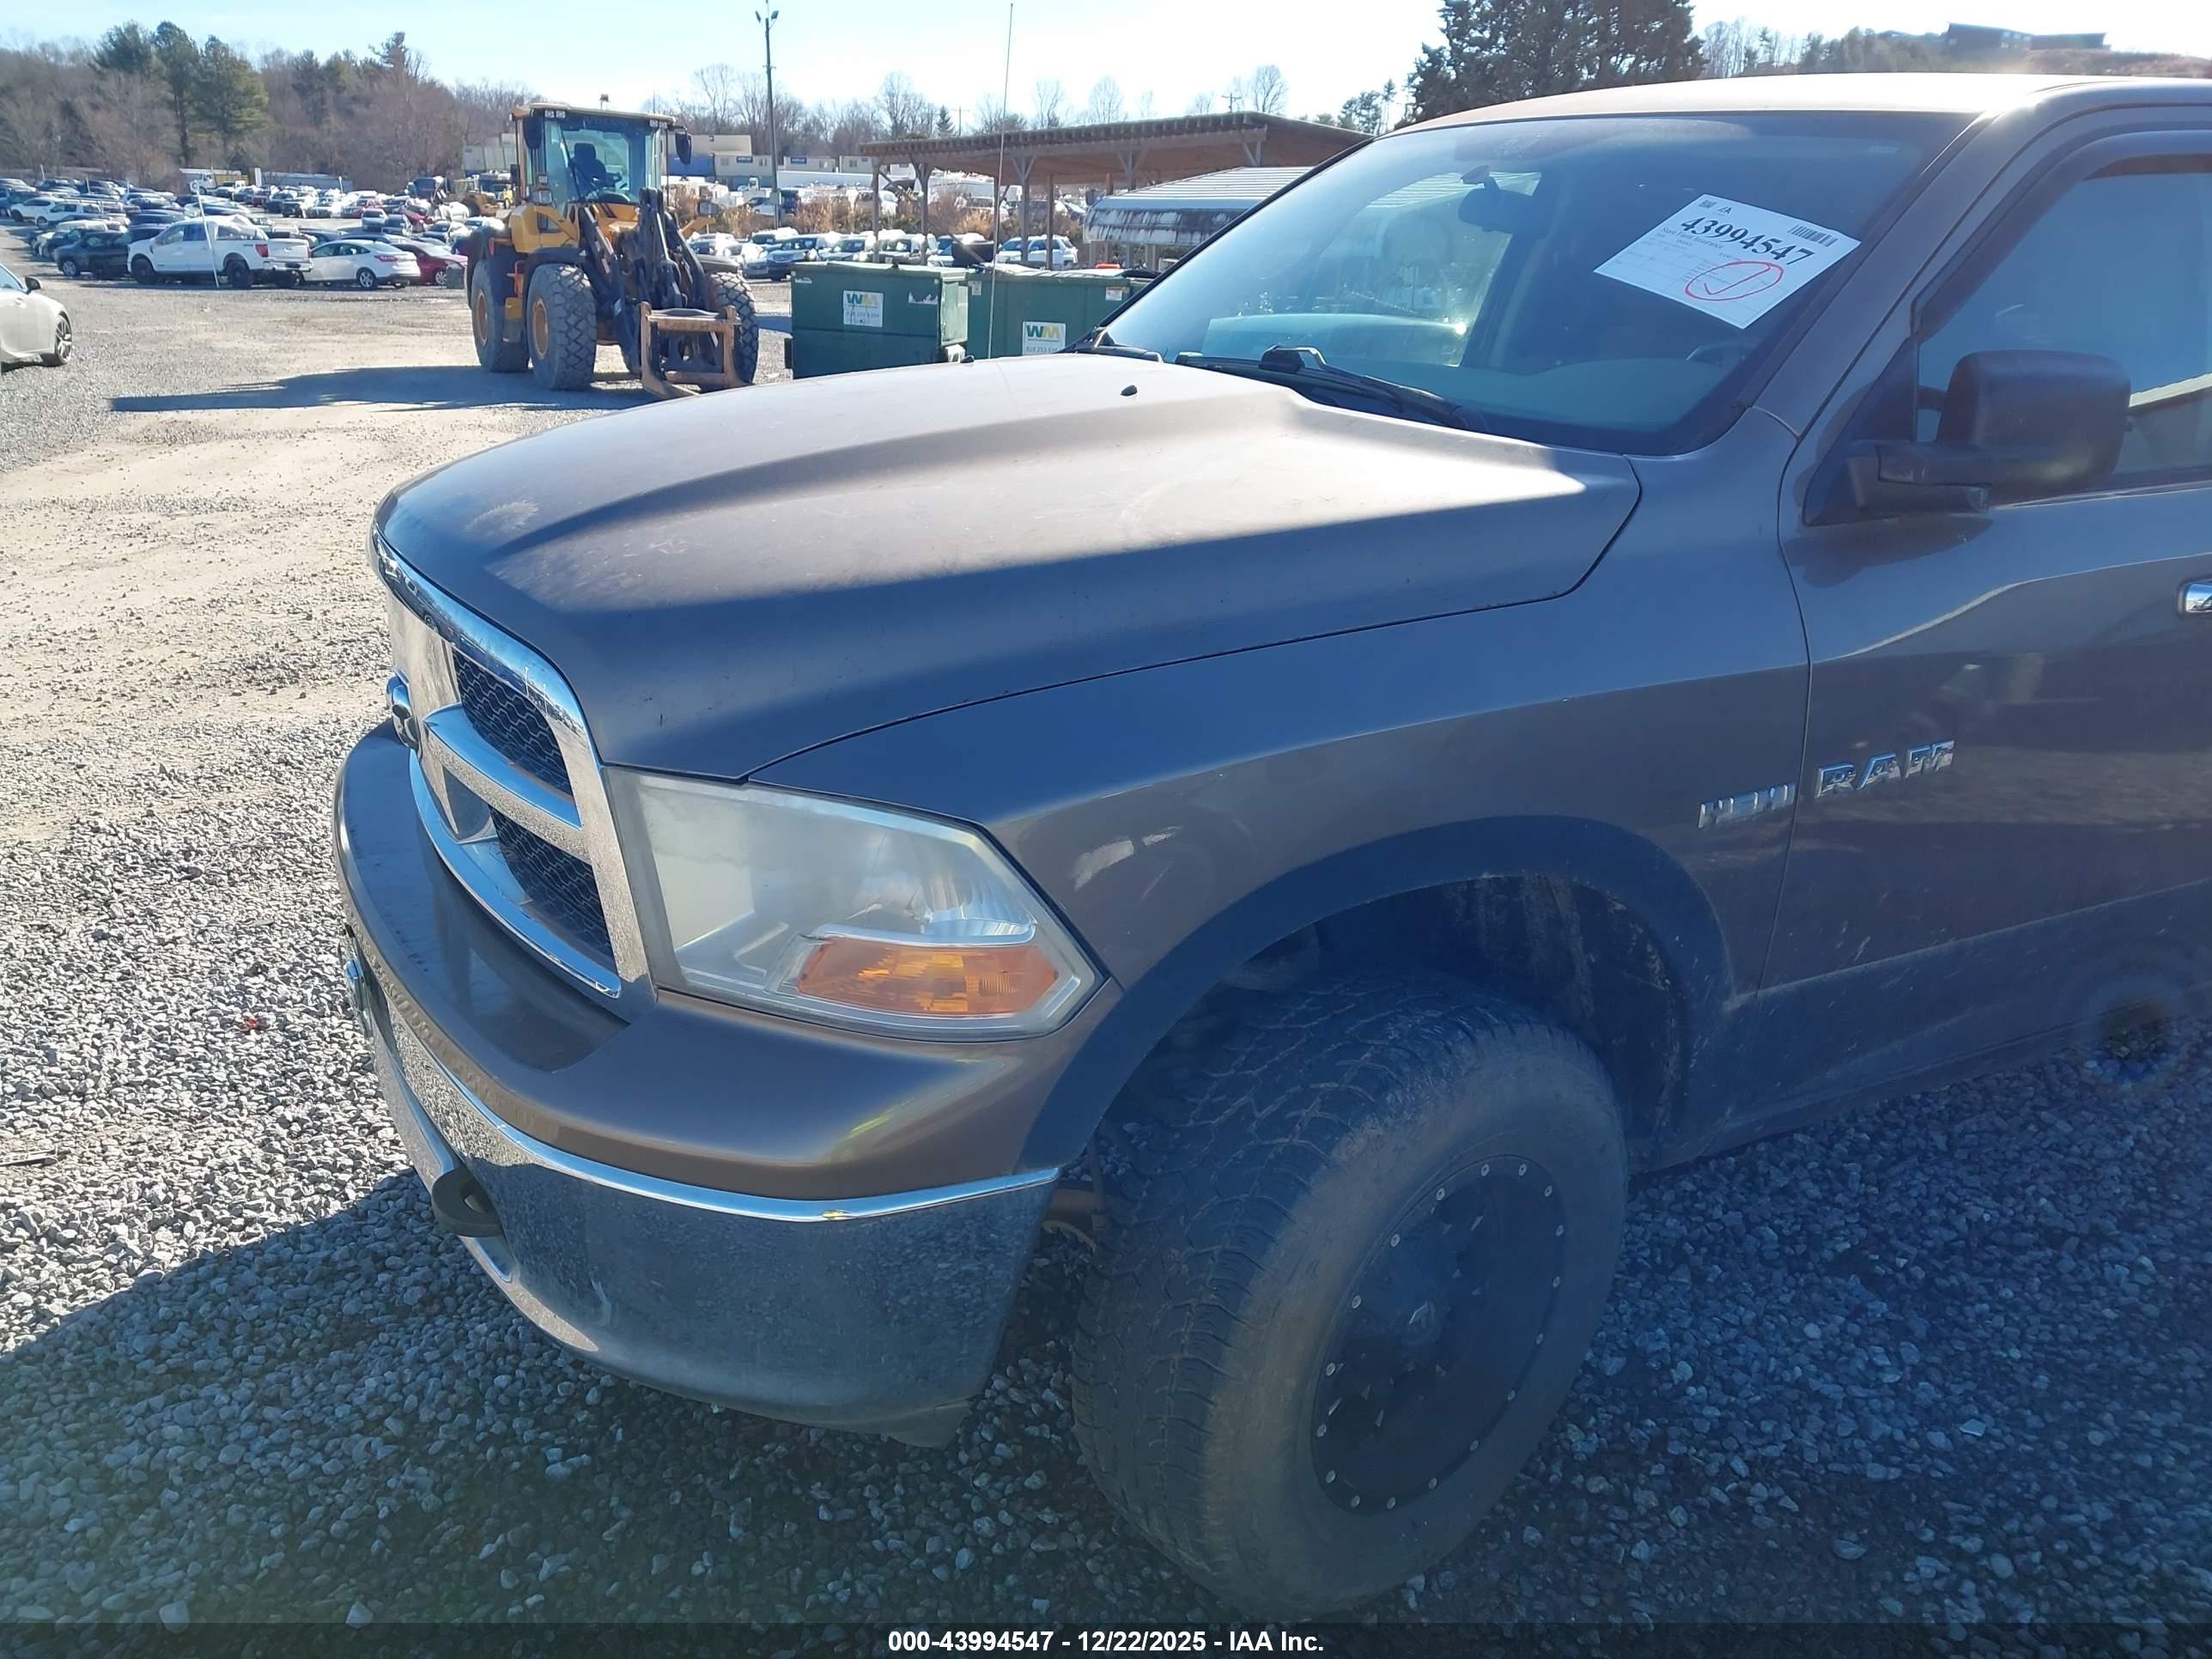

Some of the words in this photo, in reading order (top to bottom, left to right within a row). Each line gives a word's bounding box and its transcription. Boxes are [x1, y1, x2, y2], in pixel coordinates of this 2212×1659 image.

[1680, 216, 1815, 265] 43994547
[845, 293, 879, 306] WM
[1026, 325, 1060, 339] WM
[1814, 739, 1955, 799] RAM
